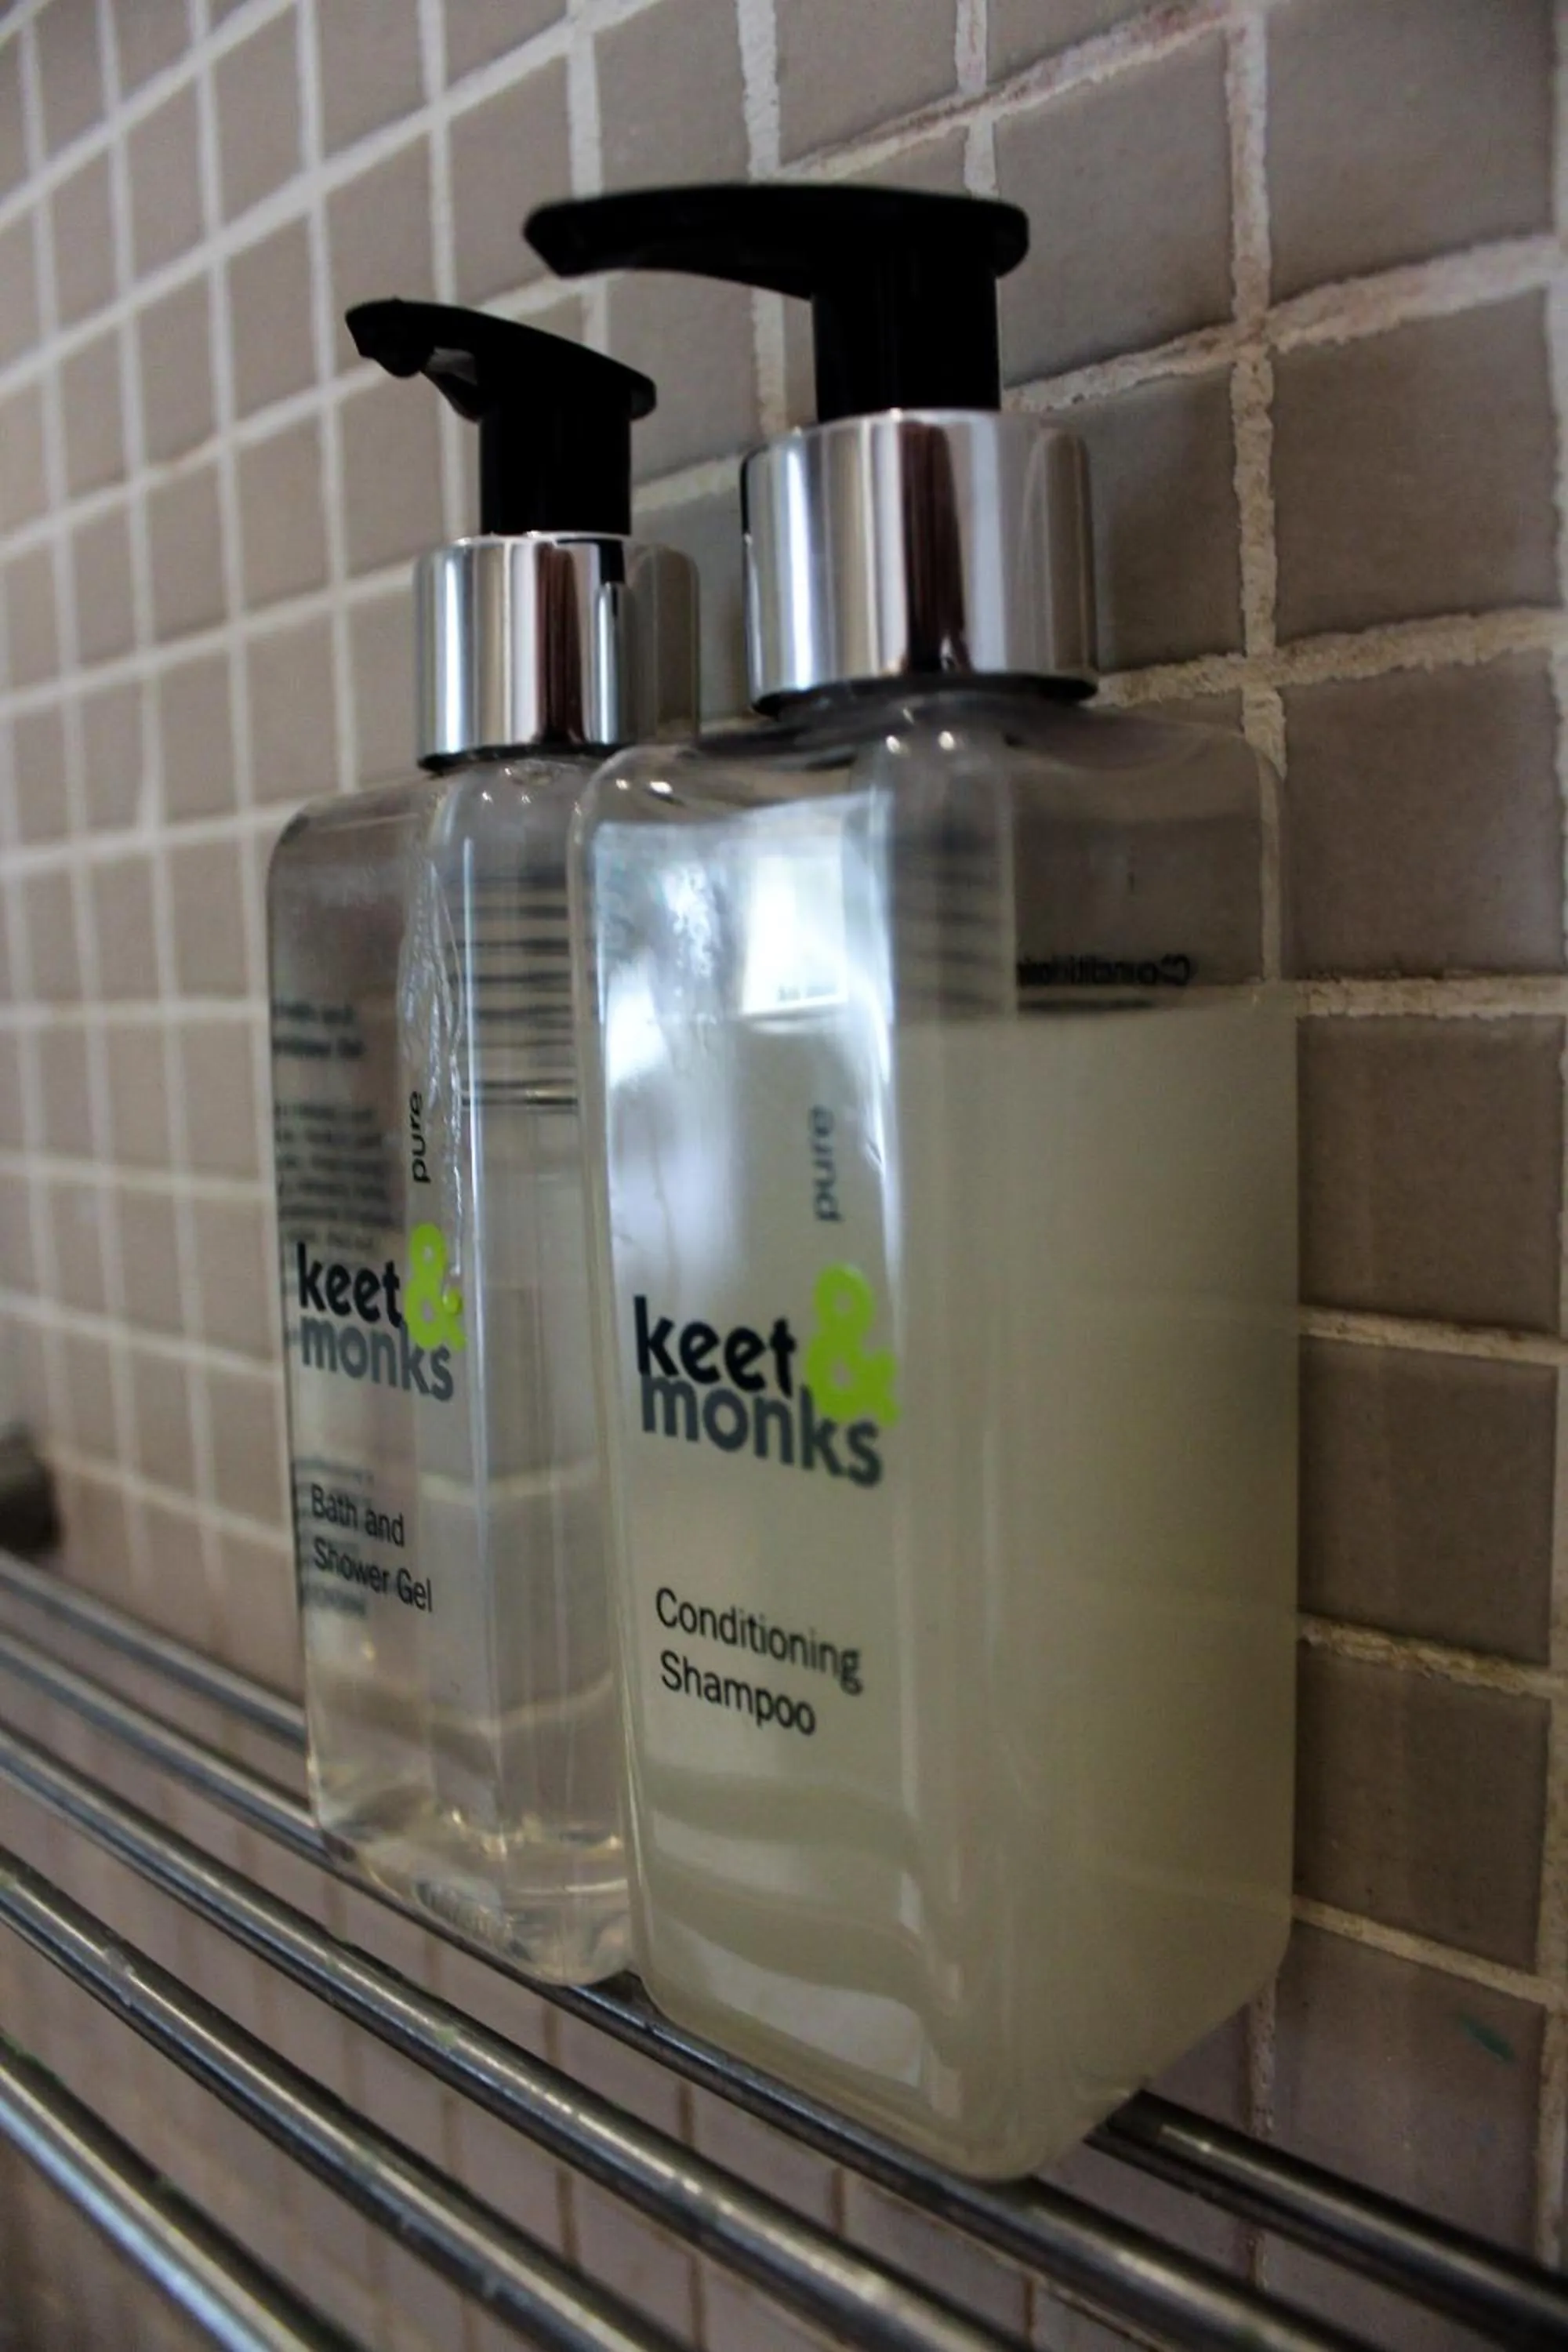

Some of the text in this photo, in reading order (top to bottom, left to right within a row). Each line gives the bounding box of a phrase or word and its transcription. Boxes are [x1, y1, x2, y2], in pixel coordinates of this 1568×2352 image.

[411, 1091, 431, 1183] pure
[808, 1105, 843, 1223] pure
[297, 1242, 403, 1328] keet
[301, 1316, 455, 1401] monks
[633, 1295, 797, 1397] keet
[641, 1373, 884, 1487] monks
[311, 1483, 405, 1548] Bath and
[313, 1537, 390, 1595] Shower
[397, 1566, 433, 1613] Gel
[655, 1588, 863, 1696] Conditioning
[659, 1651, 817, 1737] Shampoo
